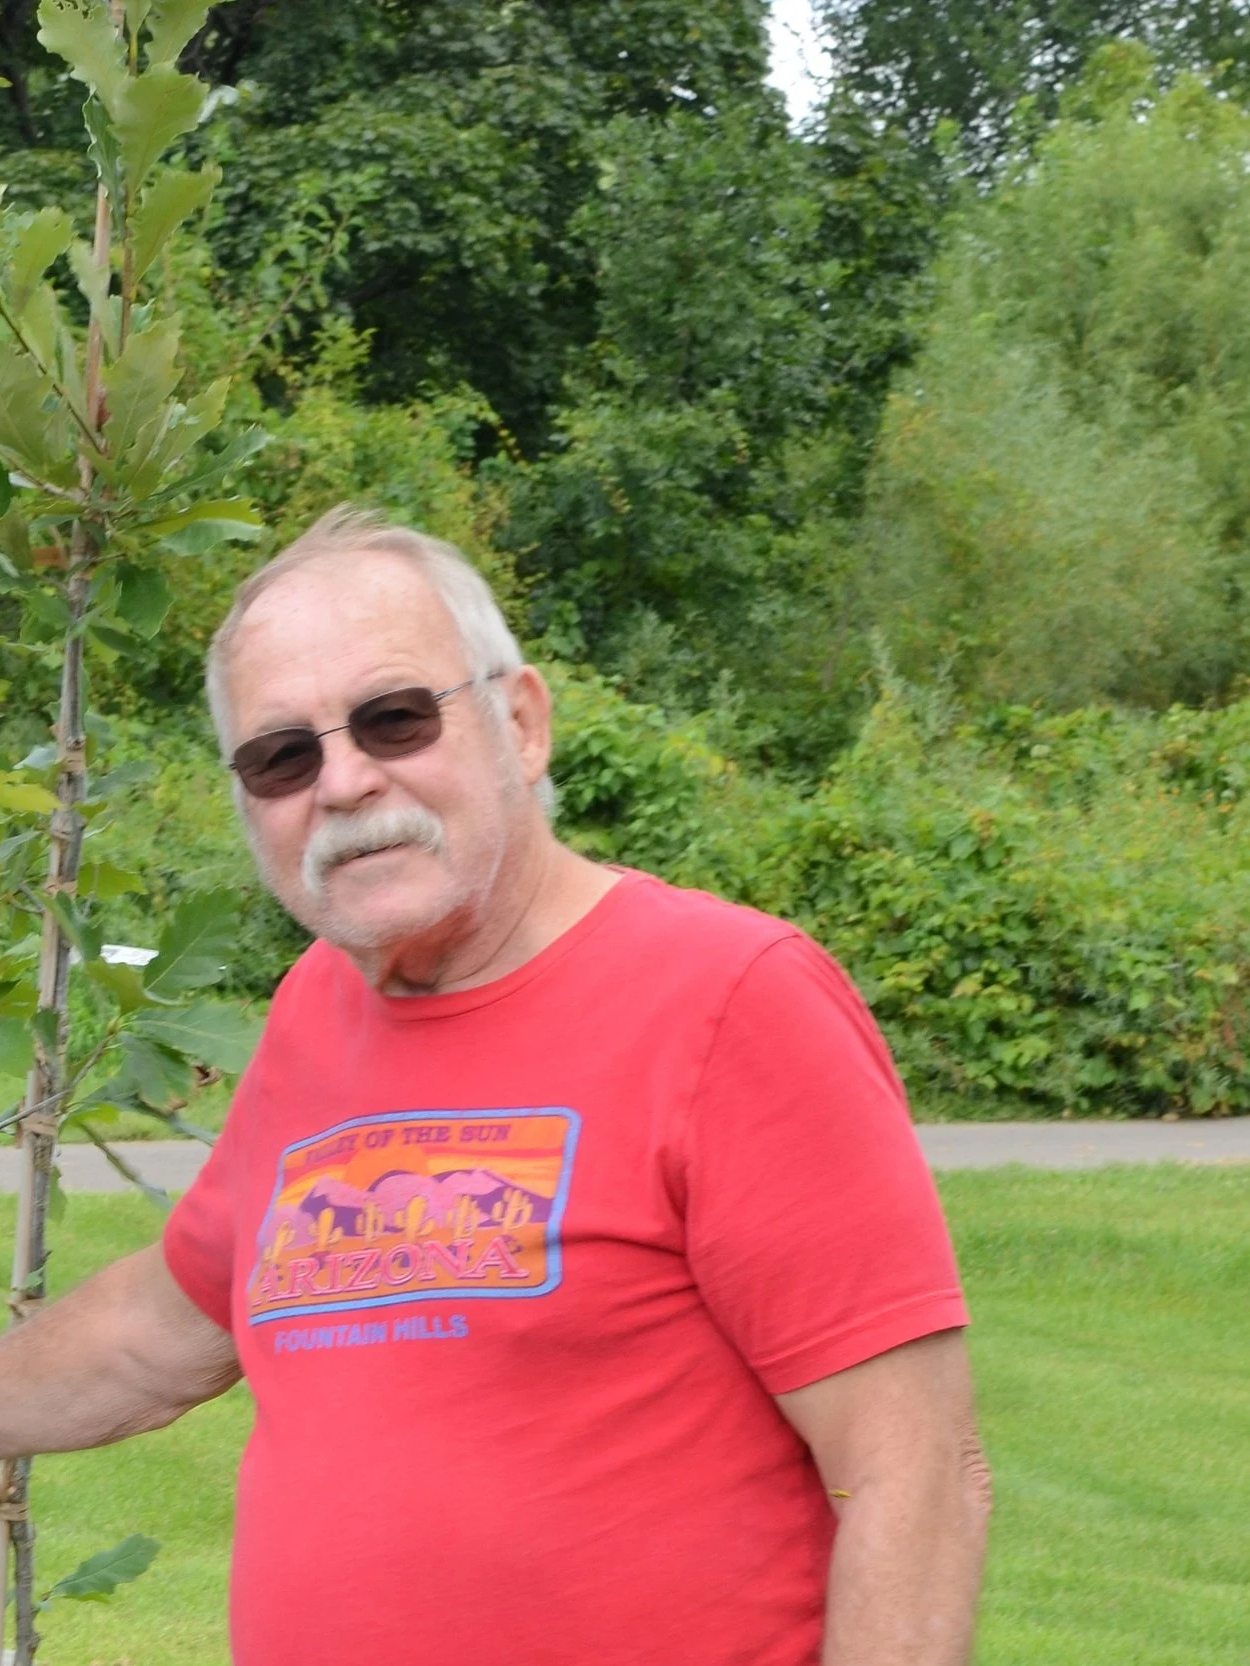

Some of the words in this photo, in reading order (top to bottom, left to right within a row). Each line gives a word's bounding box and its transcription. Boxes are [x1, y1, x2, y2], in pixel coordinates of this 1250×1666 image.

[364, 1129, 395, 1149] OF
[403, 1126, 451, 1145] THE
[459, 1124, 513, 1142] SUN
[251, 1236, 530, 1307] ARIZONA
[274, 1321, 388, 1354] FOUNTAIN
[393, 1314, 470, 1343] HILLS
